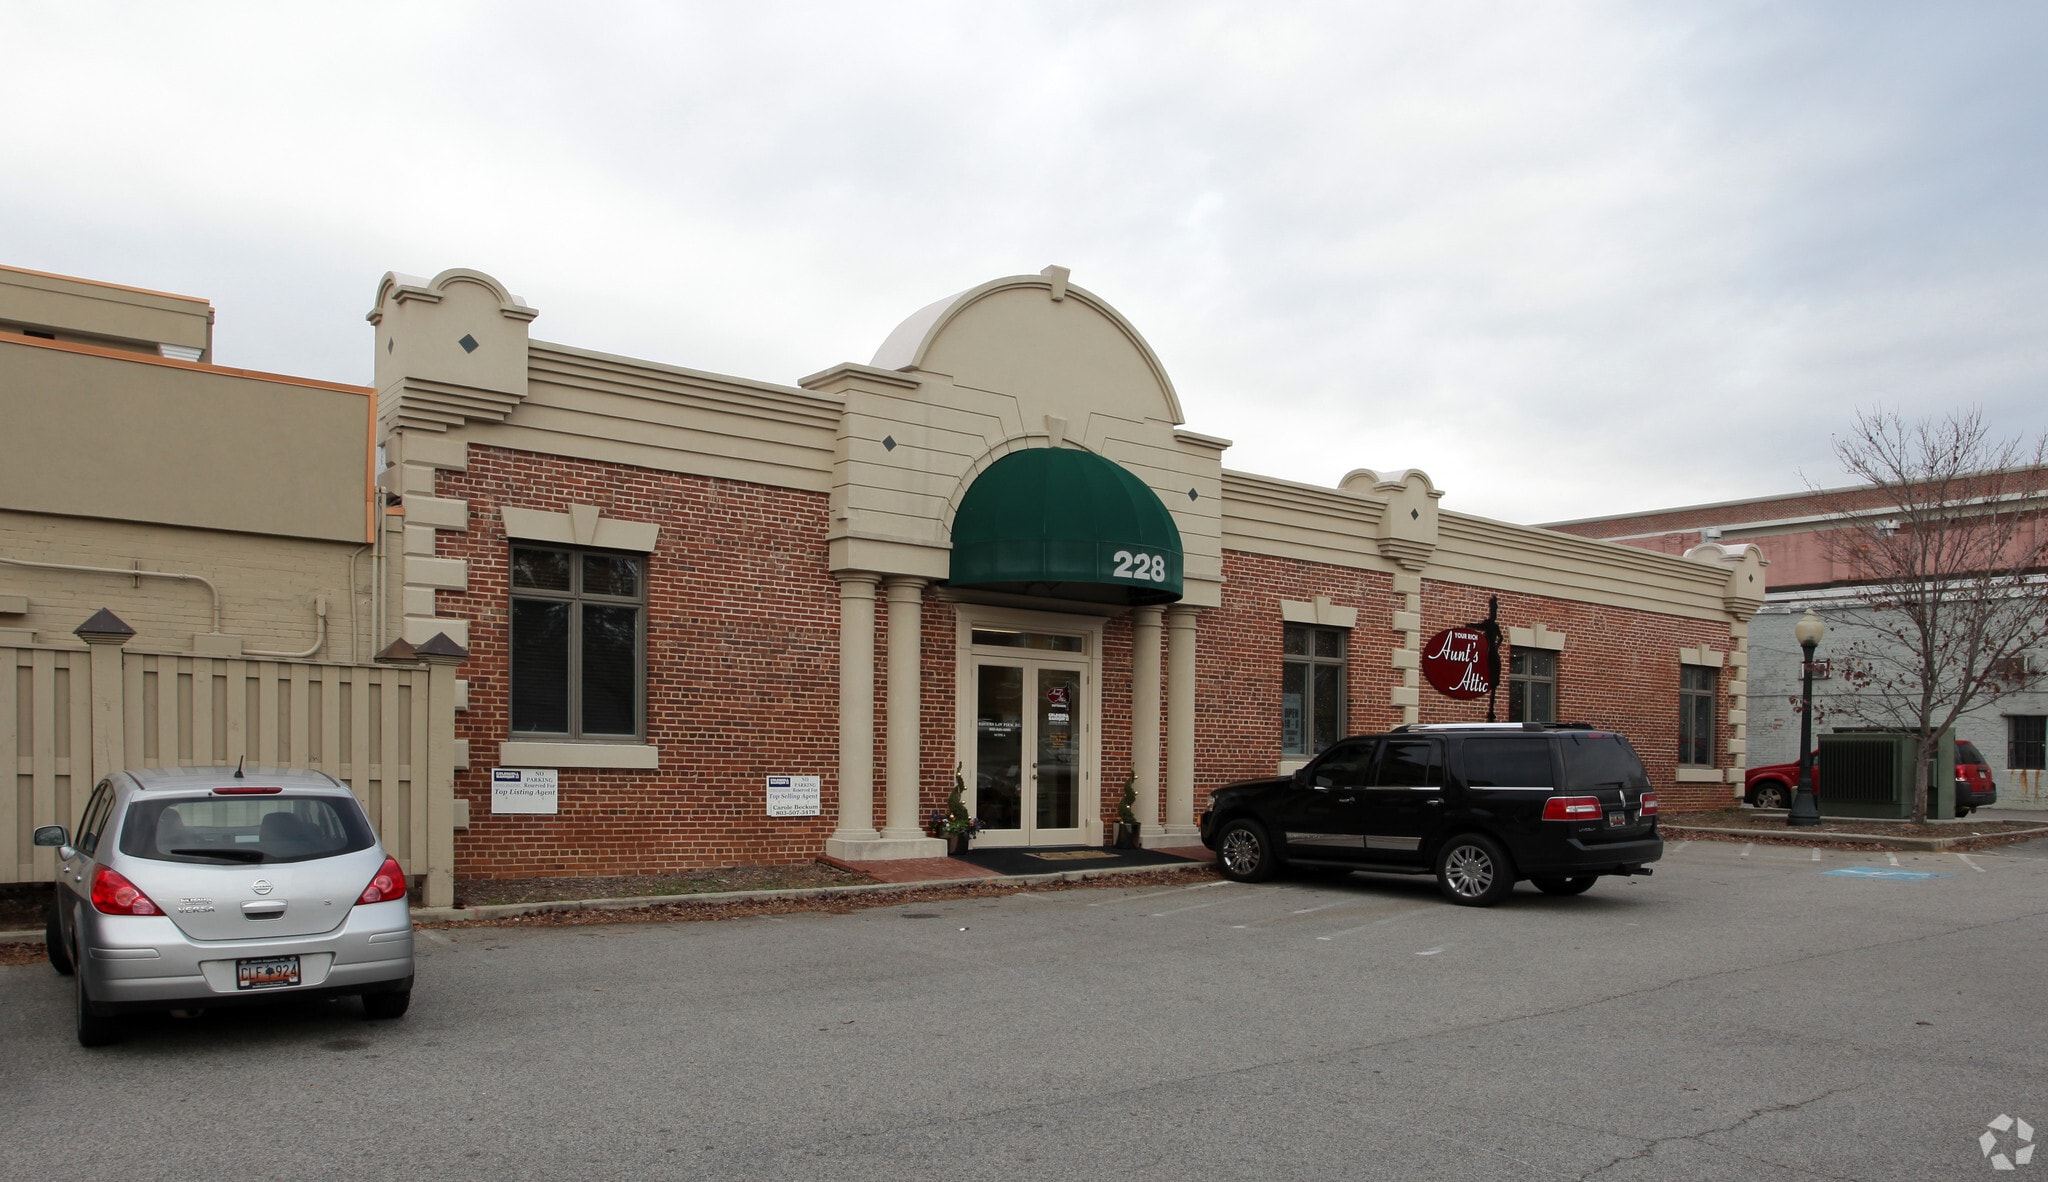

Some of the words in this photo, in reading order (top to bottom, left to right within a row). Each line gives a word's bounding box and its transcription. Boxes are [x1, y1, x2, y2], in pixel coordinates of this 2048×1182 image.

[1113, 550, 1165, 582] 228
[1428, 630, 1478, 663] Aunt's
[1449, 662, 1489, 692] Attic
[241, 966, 263, 980] CLF
[275, 964, 297, 977] 924
